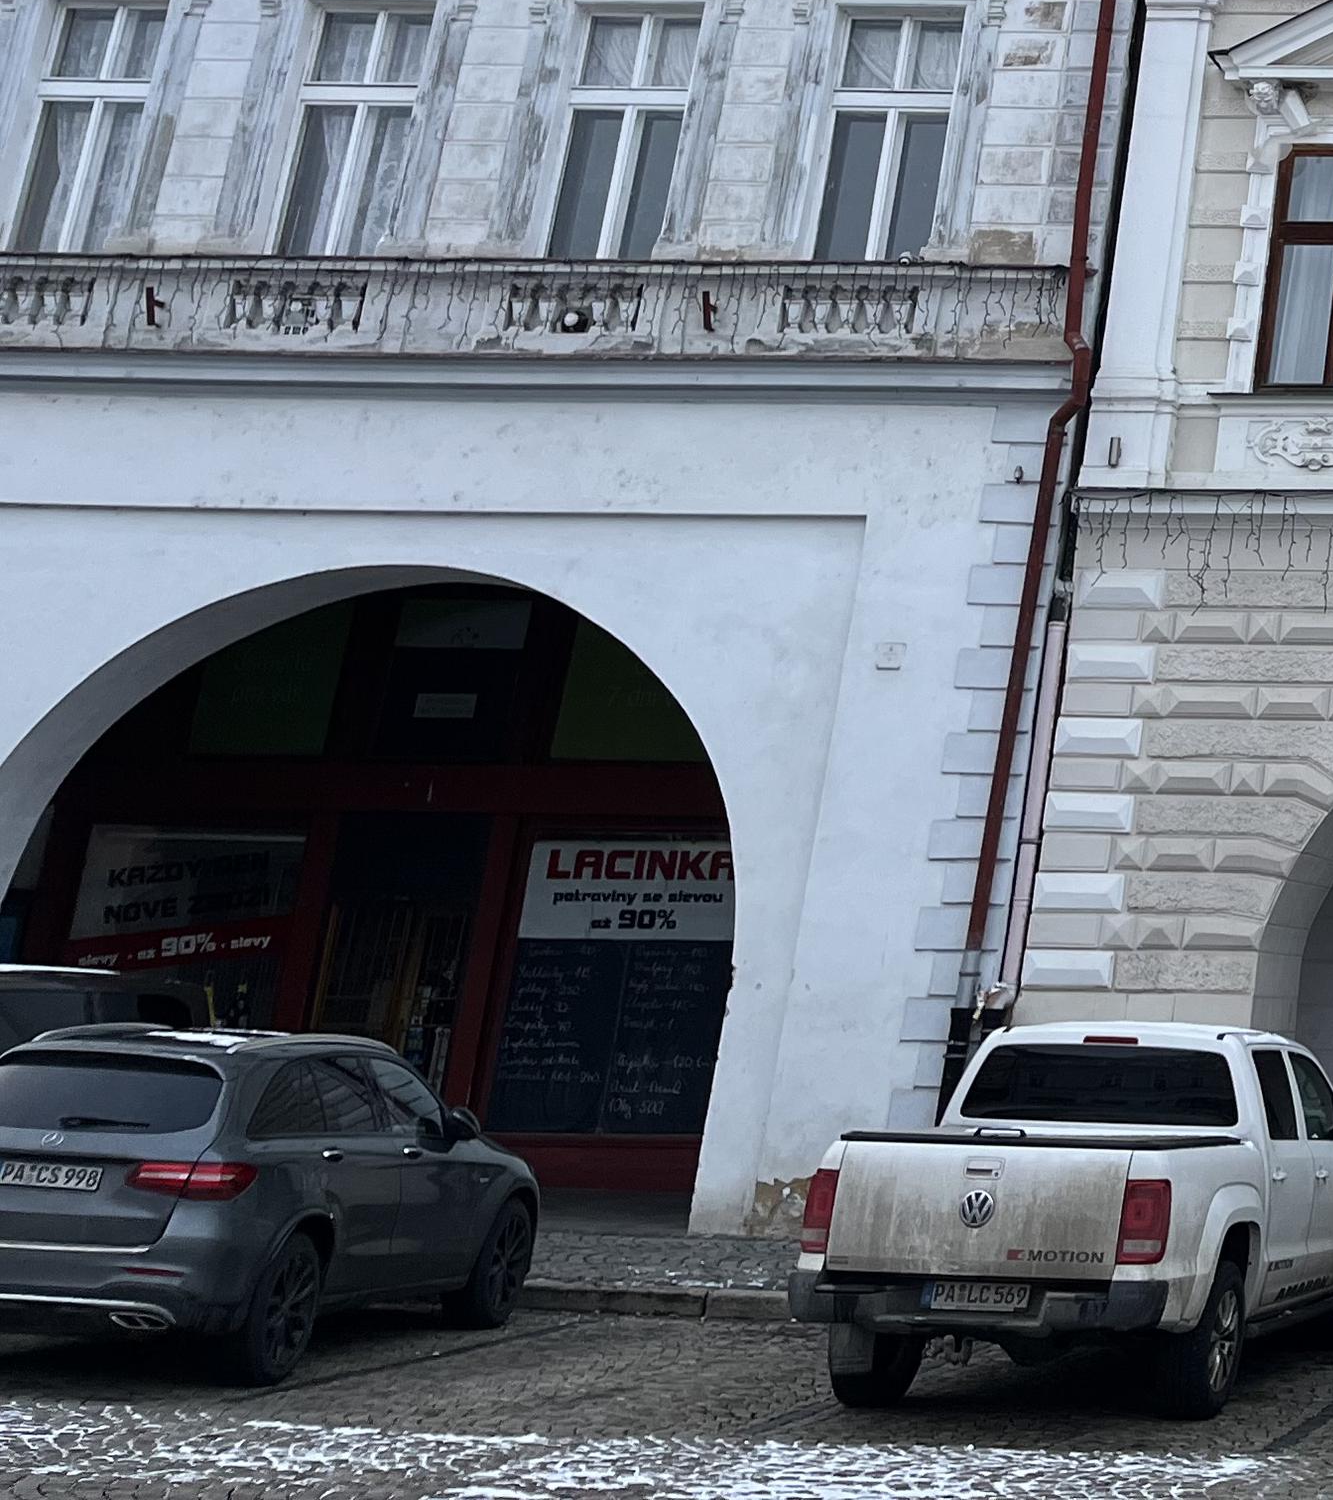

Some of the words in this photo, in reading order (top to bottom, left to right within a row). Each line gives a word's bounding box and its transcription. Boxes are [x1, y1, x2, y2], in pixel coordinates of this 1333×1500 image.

[547, 849, 734, 880] LACINKA
[618, 909, 677, 930] 90%
[1, 1163, 25, 1182] PA
[36, 1166, 62, 1184] CS
[64, 1168, 99, 1188] 998
[933, 1284, 955, 1302] PA
[967, 1284, 991, 1304] LC
[993, 1285, 1028, 1306] 569
